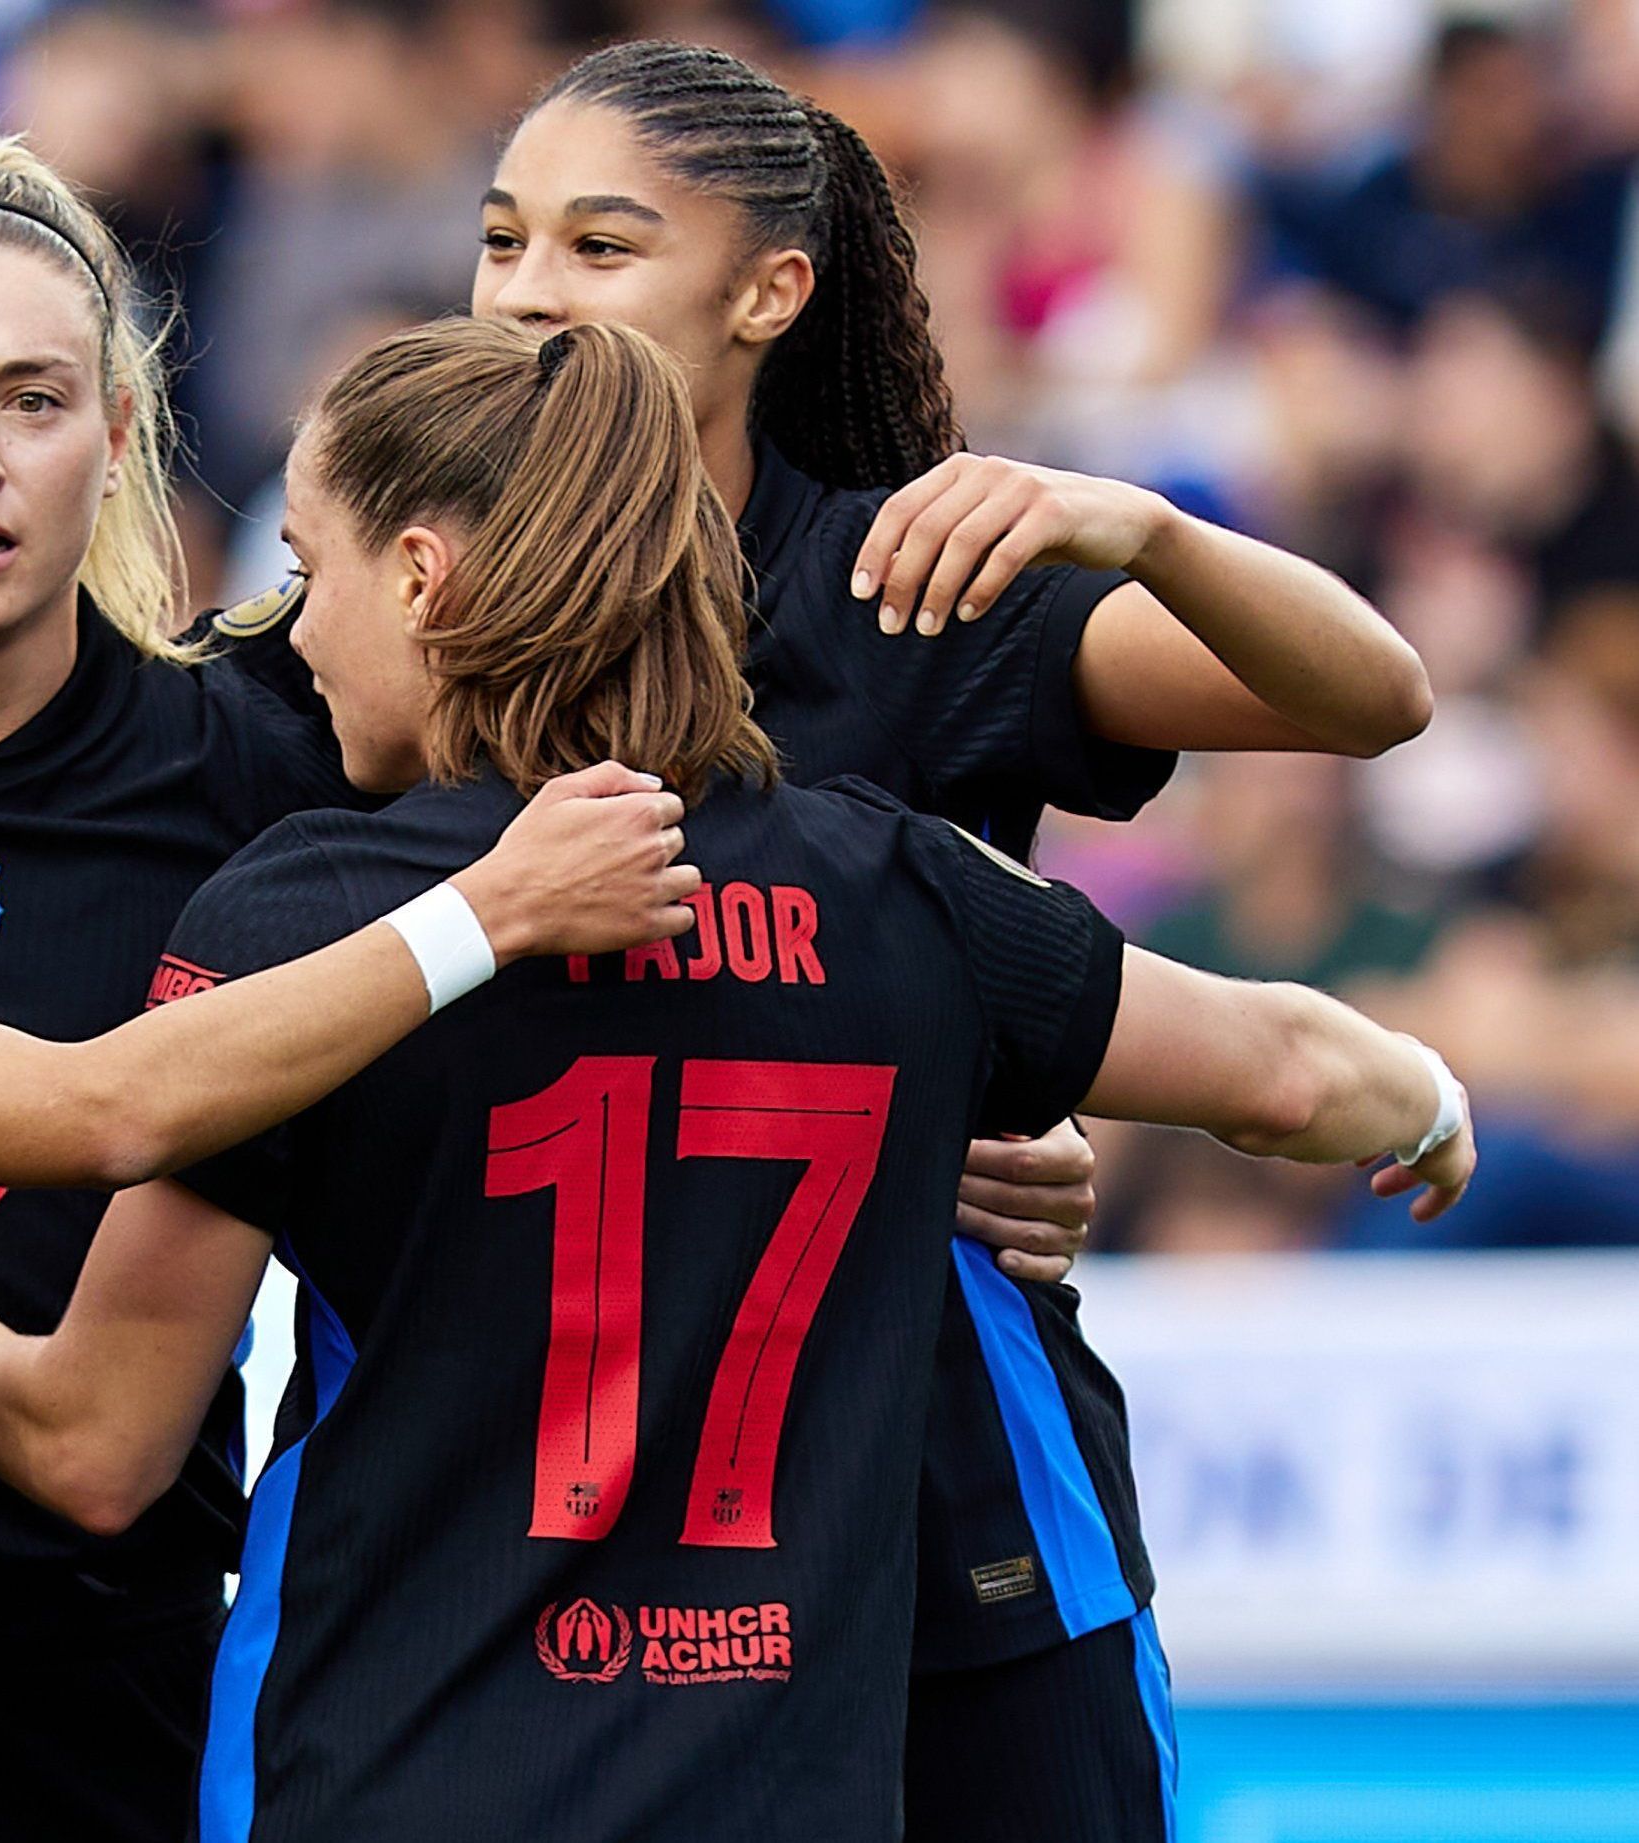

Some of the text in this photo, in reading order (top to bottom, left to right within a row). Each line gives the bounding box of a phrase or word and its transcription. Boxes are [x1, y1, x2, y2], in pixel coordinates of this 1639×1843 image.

[567, 881, 826, 985] AJOR
[484, 1055, 899, 1549] 17
[639, 1602, 791, 1640] UNHCR
[641, 1634, 792, 1672] ACNUR
[644, 1667, 792, 1685] The UN Refugee Agency
